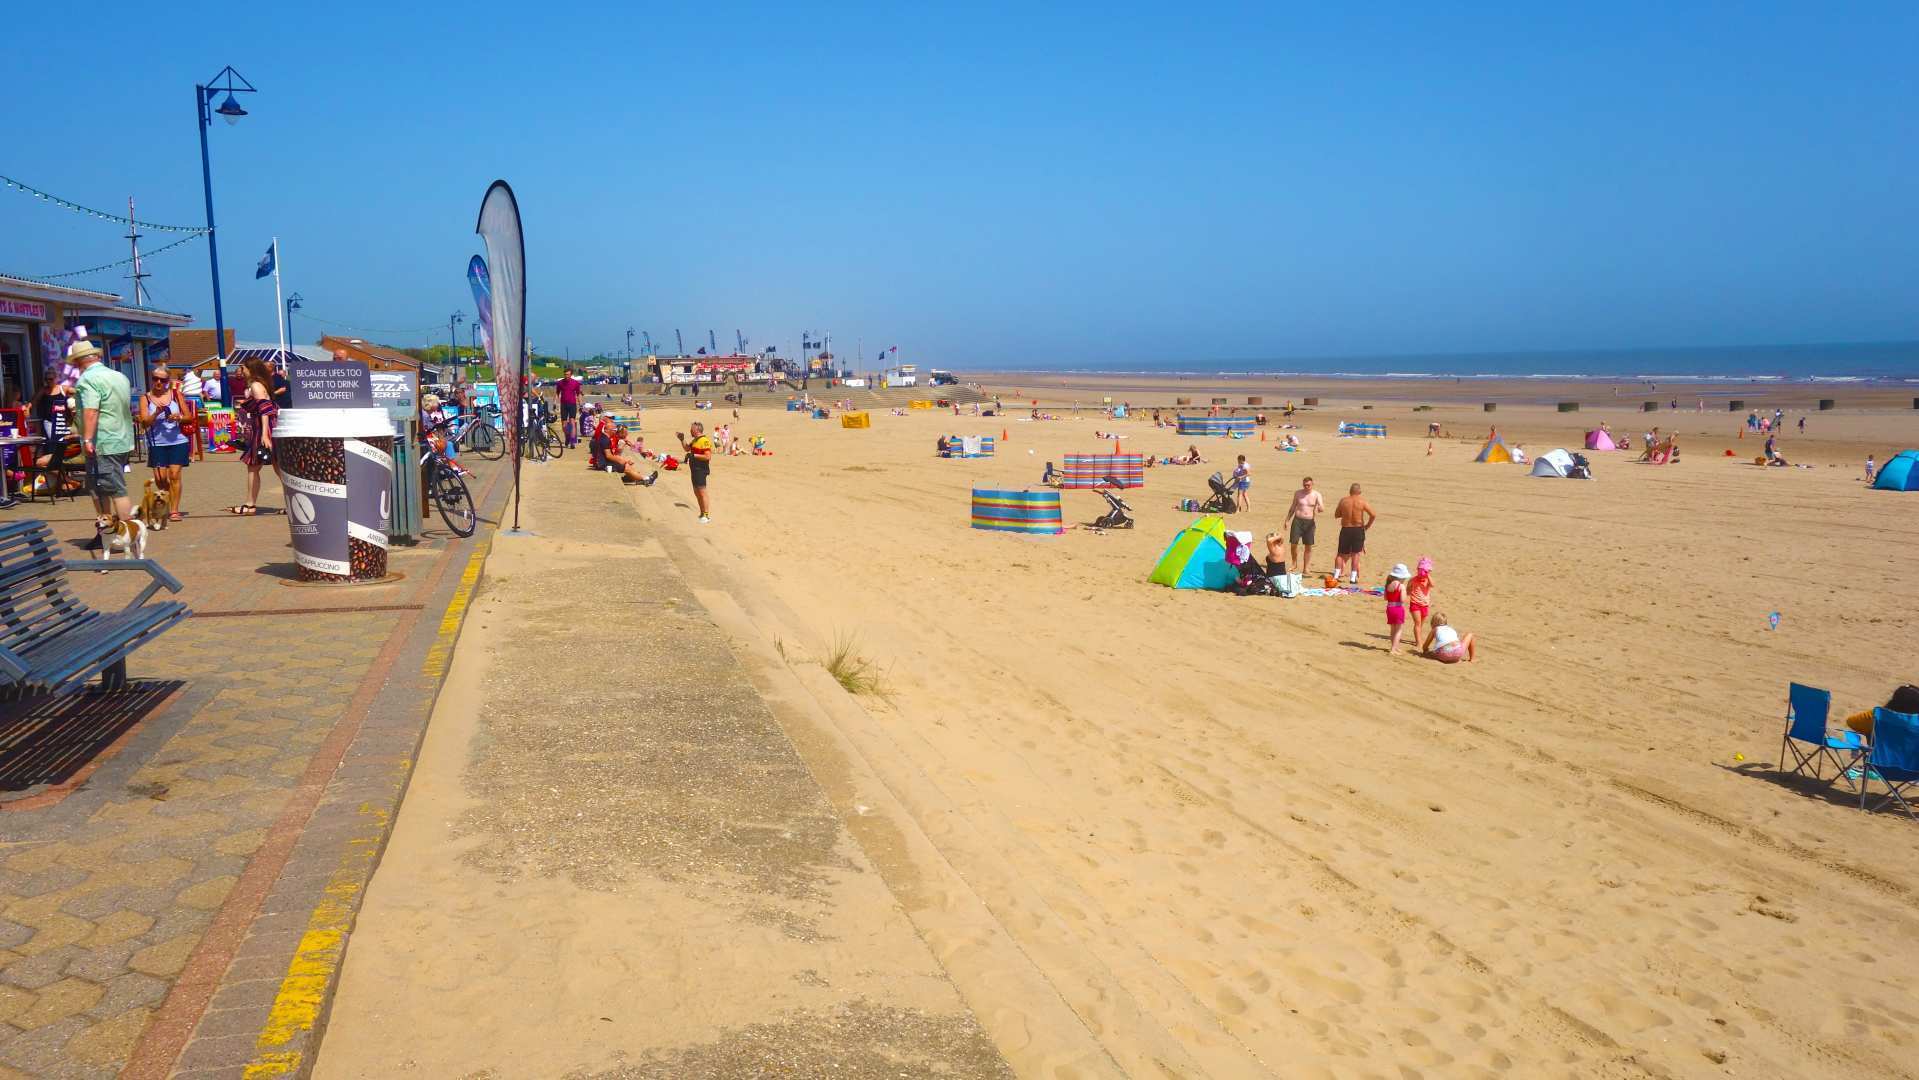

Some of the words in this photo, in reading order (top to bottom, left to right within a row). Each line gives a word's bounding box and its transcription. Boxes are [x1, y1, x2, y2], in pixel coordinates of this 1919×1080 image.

[296, 369, 328, 378] BECAUSE
[346, 369, 362, 377] TOO
[301, 380, 324, 389] SHORT
[326, 380, 336, 388] TO
[337, 380, 360, 389] DRINK
[371, 383, 411, 392] ZZA
[308, 391, 323, 400] BAD
[324, 391, 354, 400] COFFEE!!
[319, 486, 341, 495] CHOC
